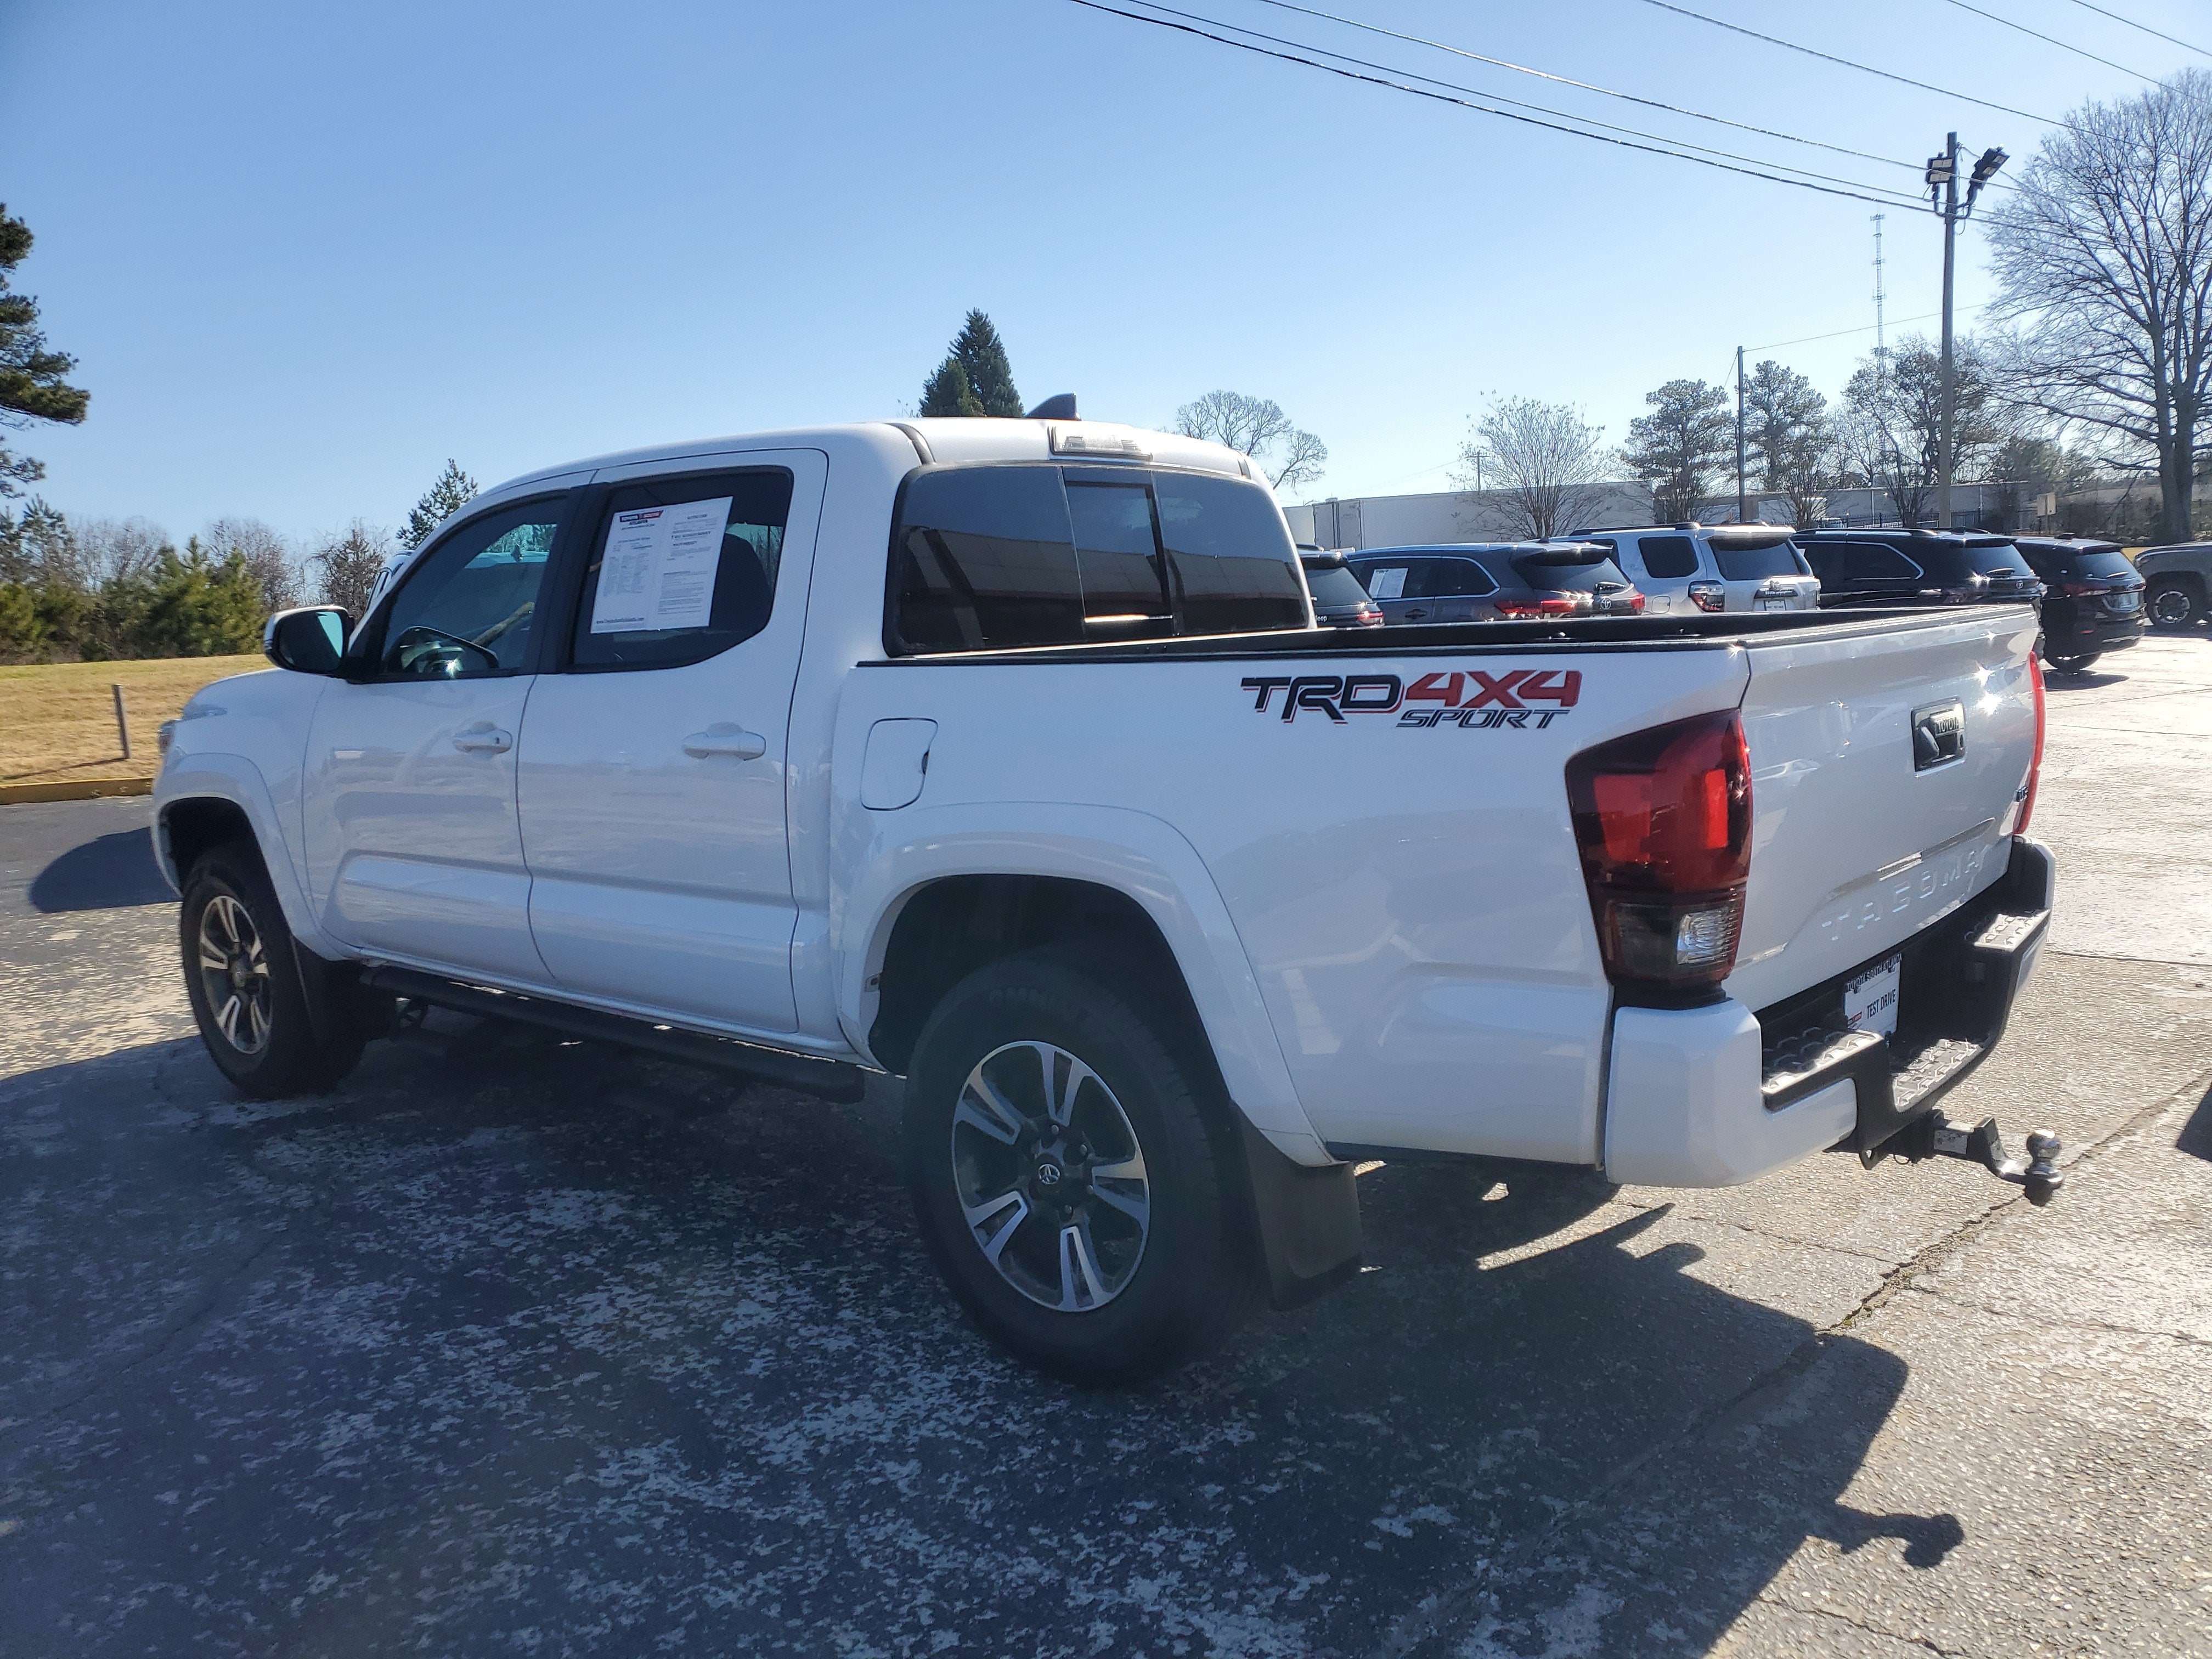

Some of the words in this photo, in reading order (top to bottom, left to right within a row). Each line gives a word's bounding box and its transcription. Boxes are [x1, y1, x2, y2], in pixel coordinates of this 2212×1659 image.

[1316, 614, 1327, 623] eep
[1241, 675, 1404, 724] TRD
[1396, 709, 1570, 729] SPORT
[1937, 716, 1960, 733] TOYOTA
[1867, 998, 1880, 1019] TEST
[1880, 989, 1896, 1011] DRIVE
